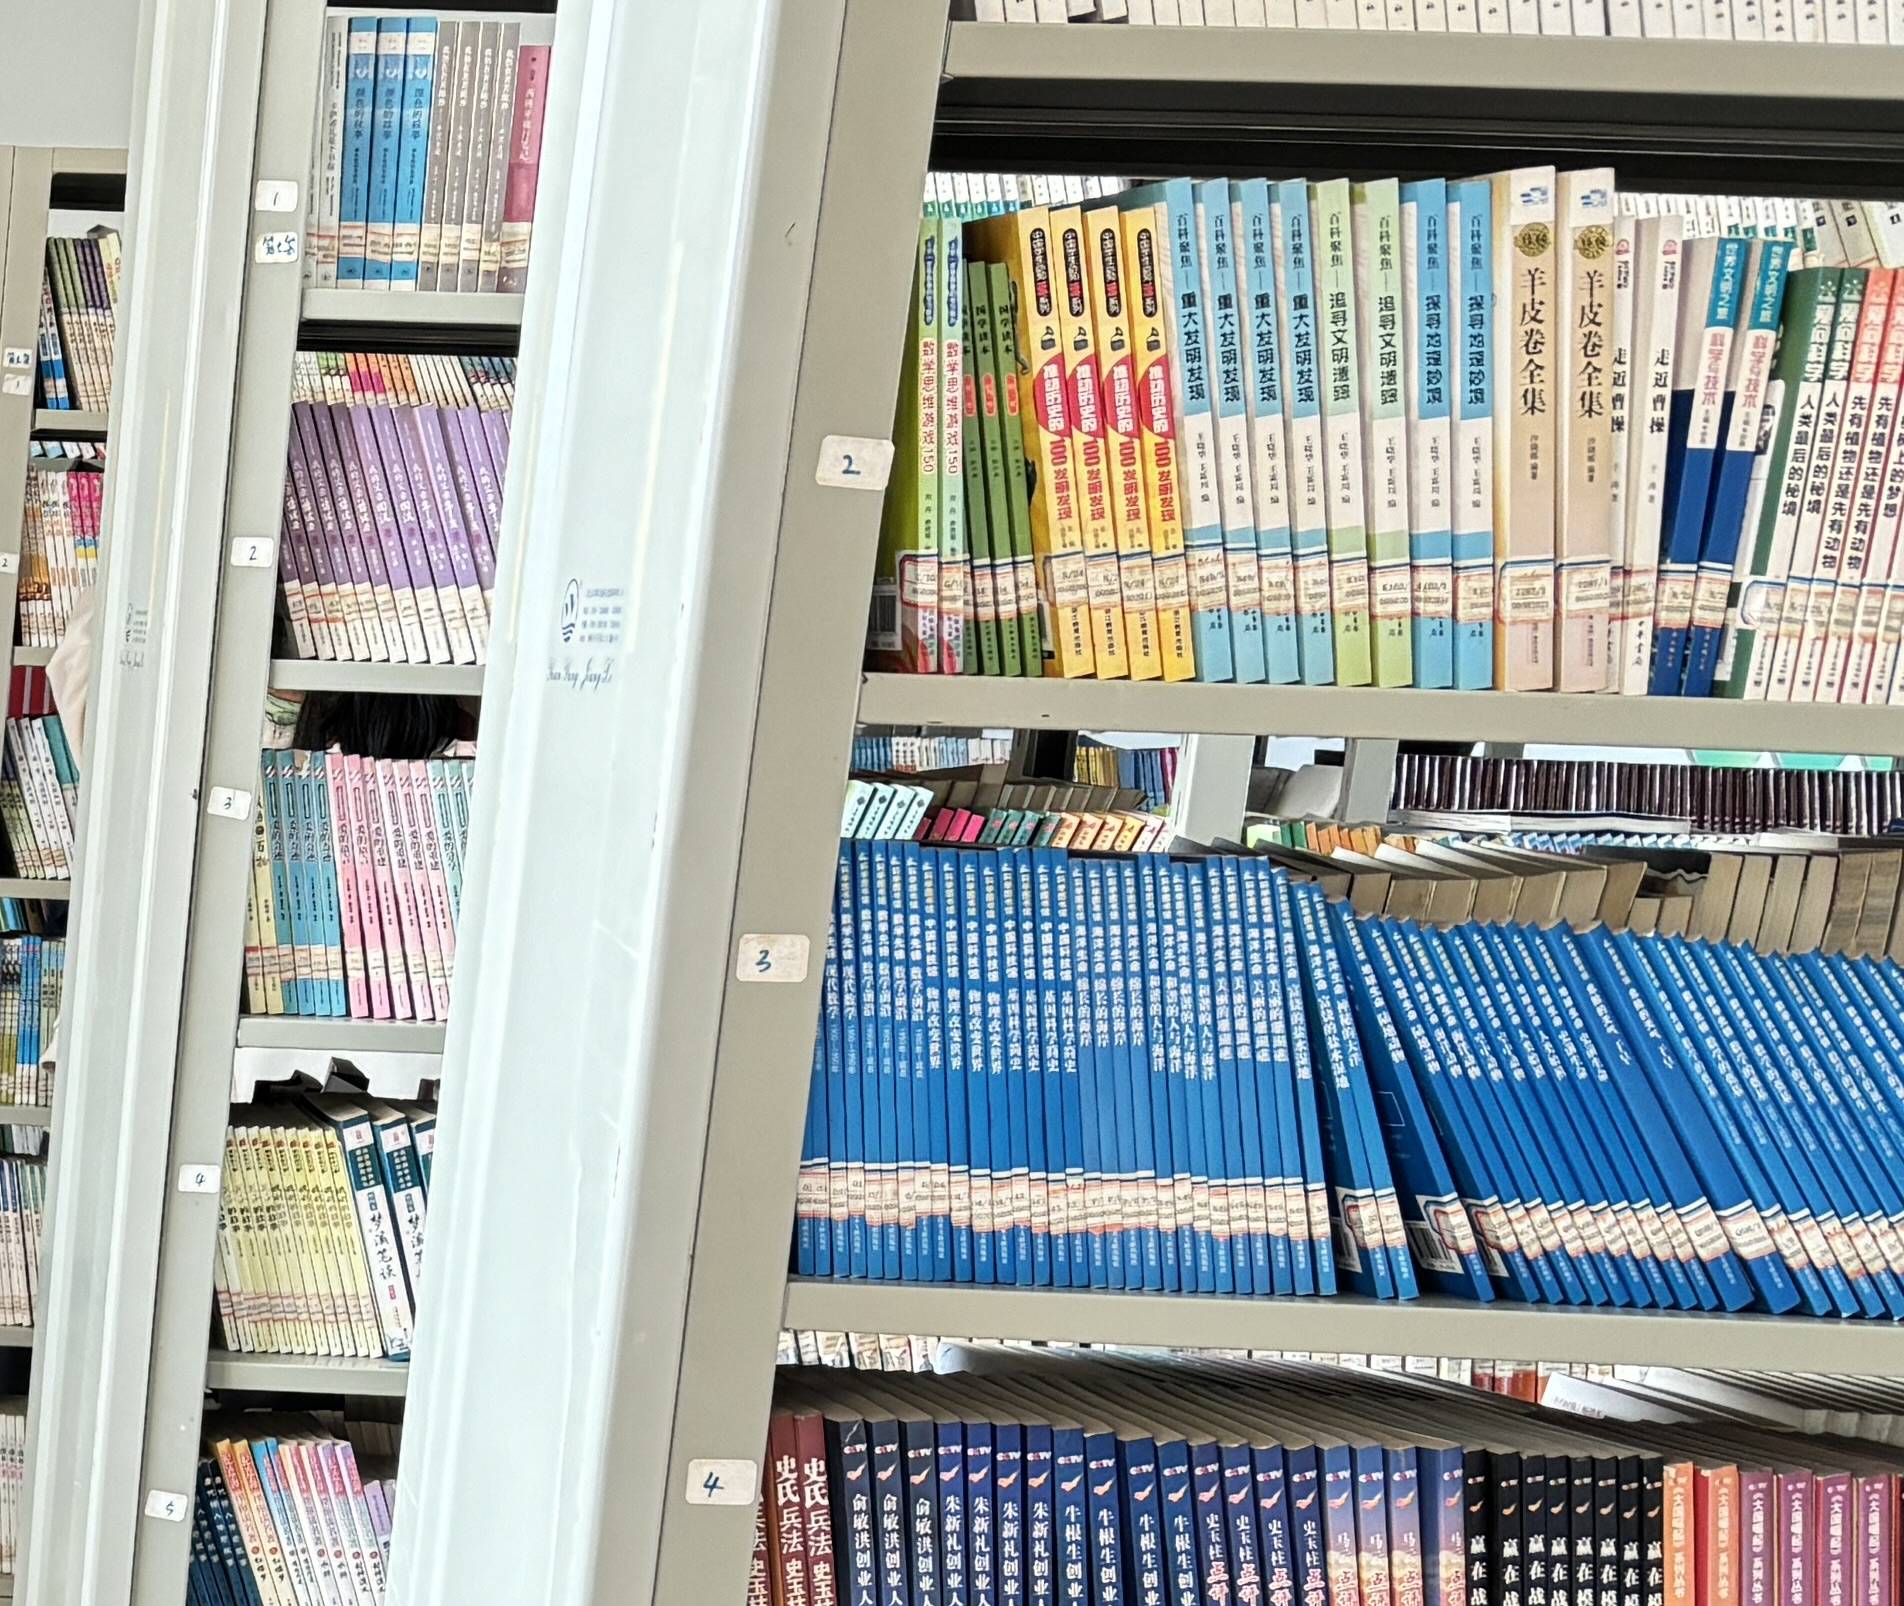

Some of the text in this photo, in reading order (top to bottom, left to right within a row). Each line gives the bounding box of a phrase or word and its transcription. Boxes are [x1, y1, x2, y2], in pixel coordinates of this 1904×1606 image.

[1180, 291, 1206, 402] 重大发明发现
[1216, 292, 1241, 403] 重大发明发现
[1254, 292, 1277, 403] 重大发明发现
[1292, 292, 1315, 404] 重大发明发现
[1518, 266, 1547, 417] 羊皮卷全集
[1576, 268, 1605, 419] 羊皮卷全集
[841, 454, 861, 475] 2
[1781, 393, 1815, 518] 人类最后的秘境
[1805, 391, 1841, 516] 人类最后的秘境
[1821, 394, 1867, 571] 先有植物还是先有动物
[1847, 395, 1893, 571] 先有植物还是先有动物
[755, 949, 772, 973] 3
[702, 1471, 725, 1498] 4
[775, 1454, 805, 1556] 史氏兵法
[802, 1456, 834, 1558] 史氏兵法
